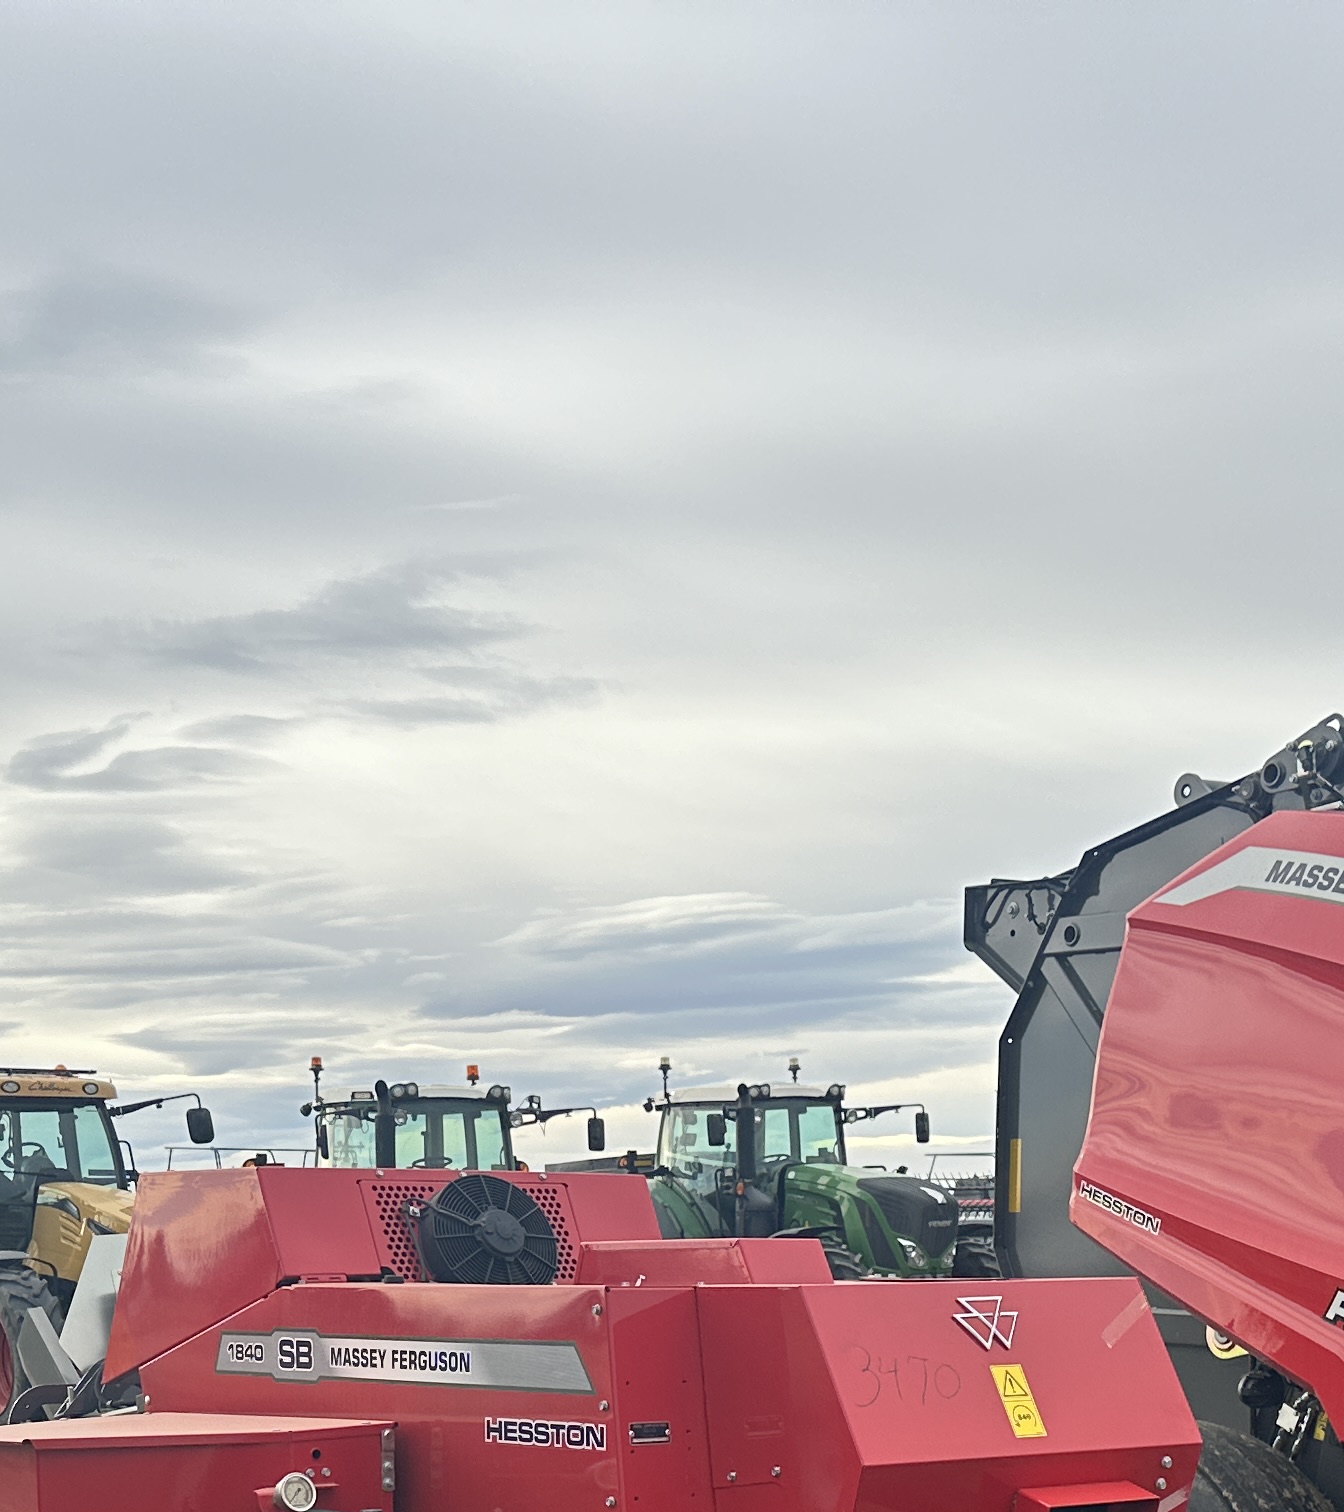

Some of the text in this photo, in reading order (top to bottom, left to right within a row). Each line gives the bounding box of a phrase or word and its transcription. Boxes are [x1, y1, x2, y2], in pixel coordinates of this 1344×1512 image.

[1080, 1180, 1161, 1236] HESSTON
[227, 1337, 472, 1374] 1840 SB MASSEY FERGUSON
[852, 1344, 962, 1408] 3470
[484, 1416, 607, 1451] HESSTON
